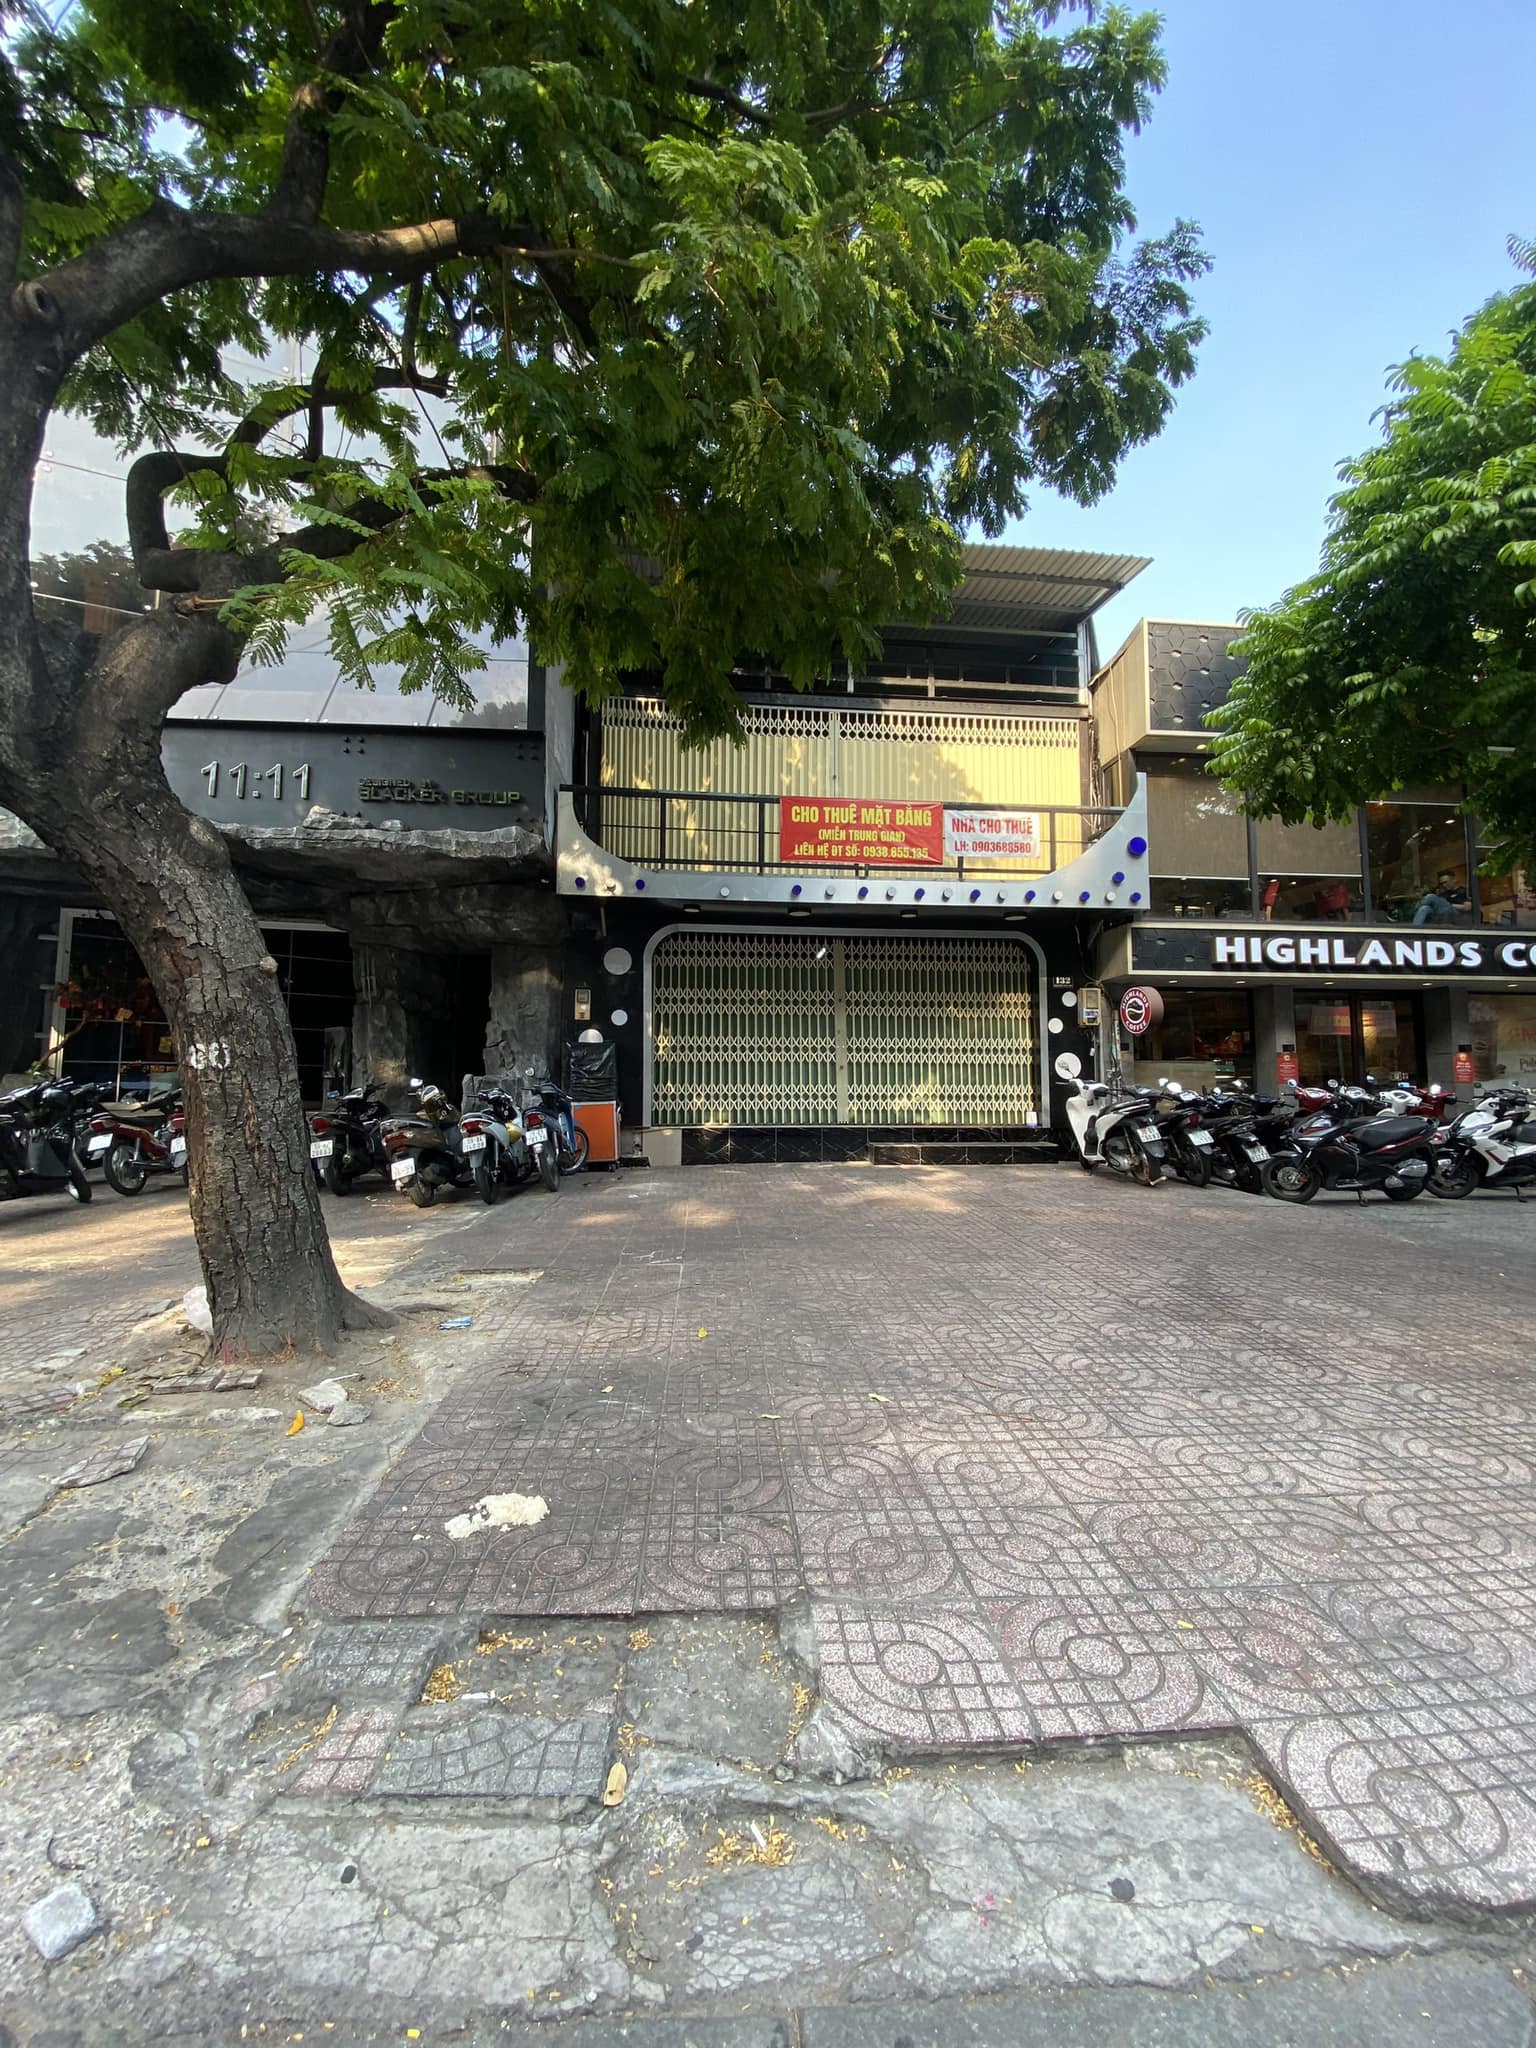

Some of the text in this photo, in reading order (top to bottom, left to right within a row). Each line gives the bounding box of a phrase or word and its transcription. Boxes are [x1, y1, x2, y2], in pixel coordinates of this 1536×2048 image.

[200, 760, 309, 800] 11:11
[451, 789, 520, 804] GROUP
[791, 804, 932, 828] CHO THUÊ MẶT BẰNG
[979, 818, 1001, 834] CHO
[849, 830, 878, 842] TRUNG
[794, 841, 815, 856] LIÊN
[817, 842, 830, 859] HỆ
[954, 840, 969, 852] LH:
[1214, 936, 1536, 967] HIGHLANDS C
[1125, 1019, 1147, 1031] COFFEE
